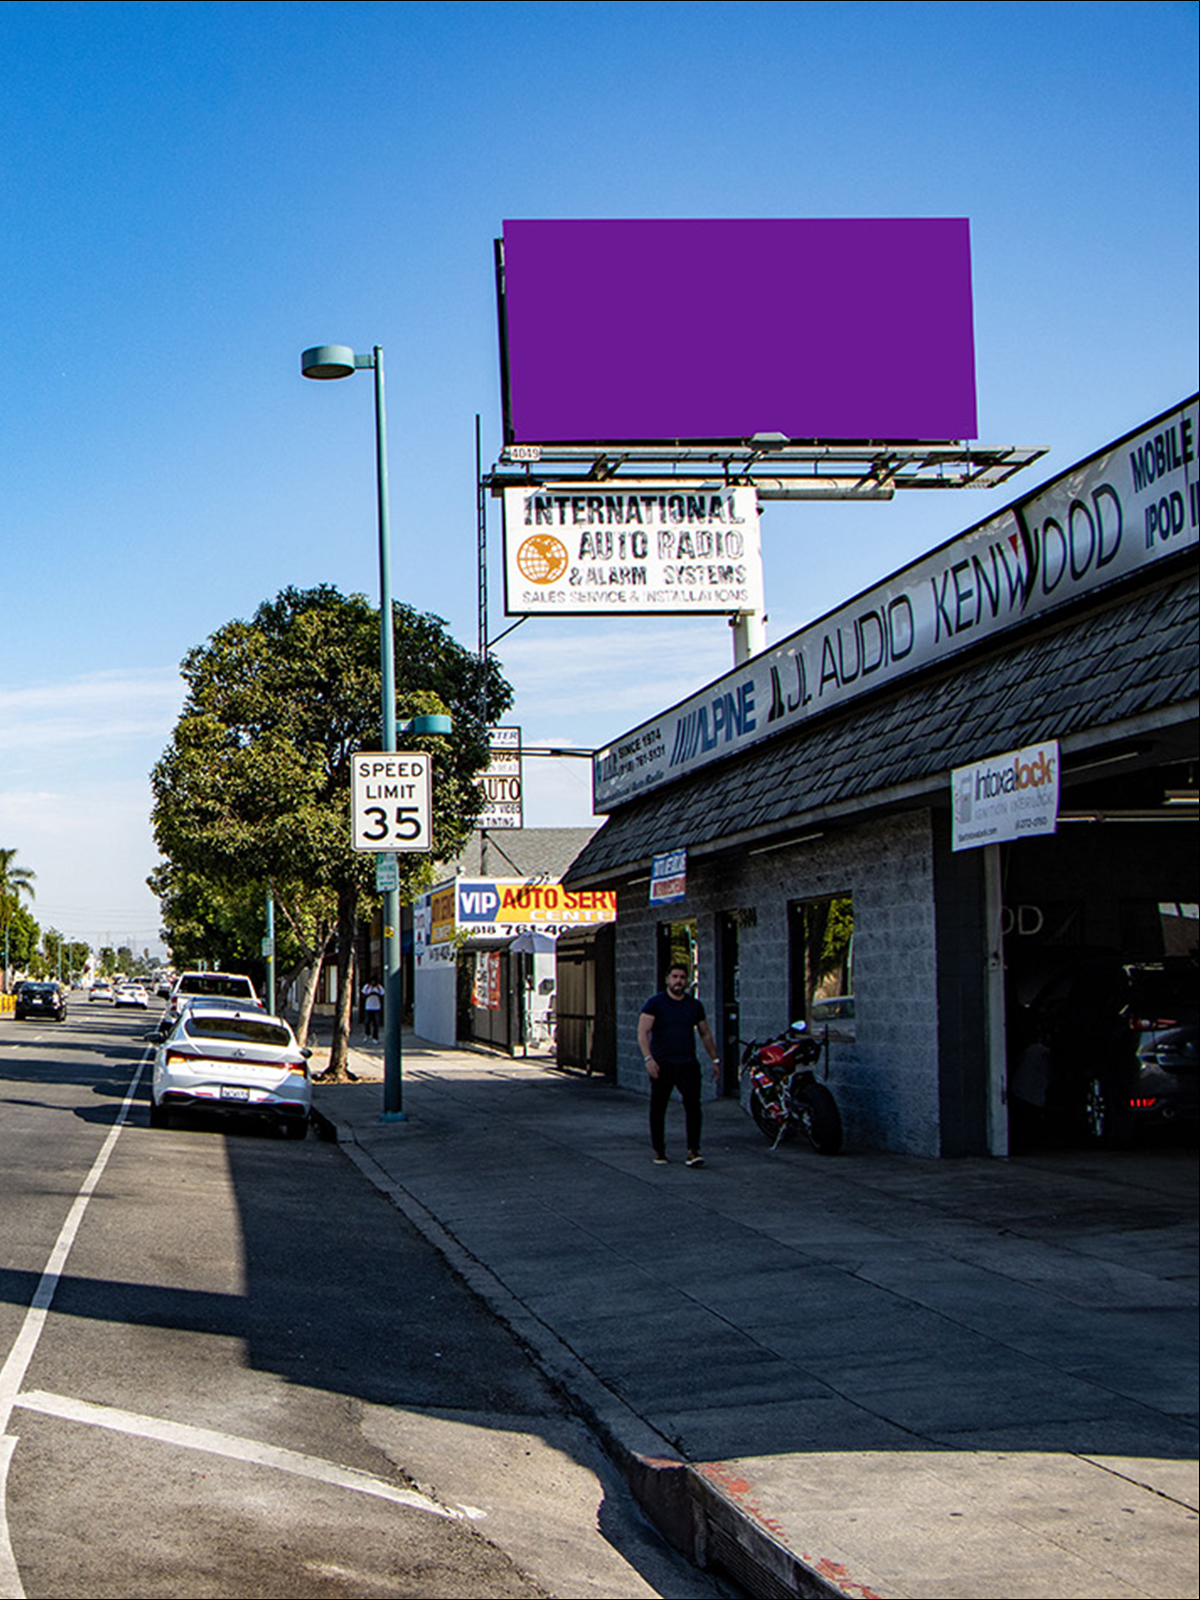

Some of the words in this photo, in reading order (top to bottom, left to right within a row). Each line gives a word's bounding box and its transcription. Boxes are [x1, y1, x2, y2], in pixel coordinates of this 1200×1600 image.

[511, 447, 540, 459] 4049
[1129, 417, 1194, 494] MOBILE
[523, 495, 746, 527] INTERNATIONAL
[578, 530, 650, 562] AUTO
[657, 530, 745, 562] RADIO
[568, 567, 583, 586] &
[586, 566, 648, 586] ALARM
[663, 564, 748, 586] SYSTEMS
[930, 483, 1123, 644] KENWOOD
[522, 590, 567, 604] SALES
[569, 589, 627, 604] SERVICE
[644, 587, 750, 603] INSTALLATIONS
[818, 593, 915, 697] AUDIO
[359, 762, 423, 778] SPEED
[366, 784, 416, 800] LIMIT
[362, 806, 422, 842] 35
[460, 891, 497, 914] VIP
[502, 887, 558, 909] AUTO
